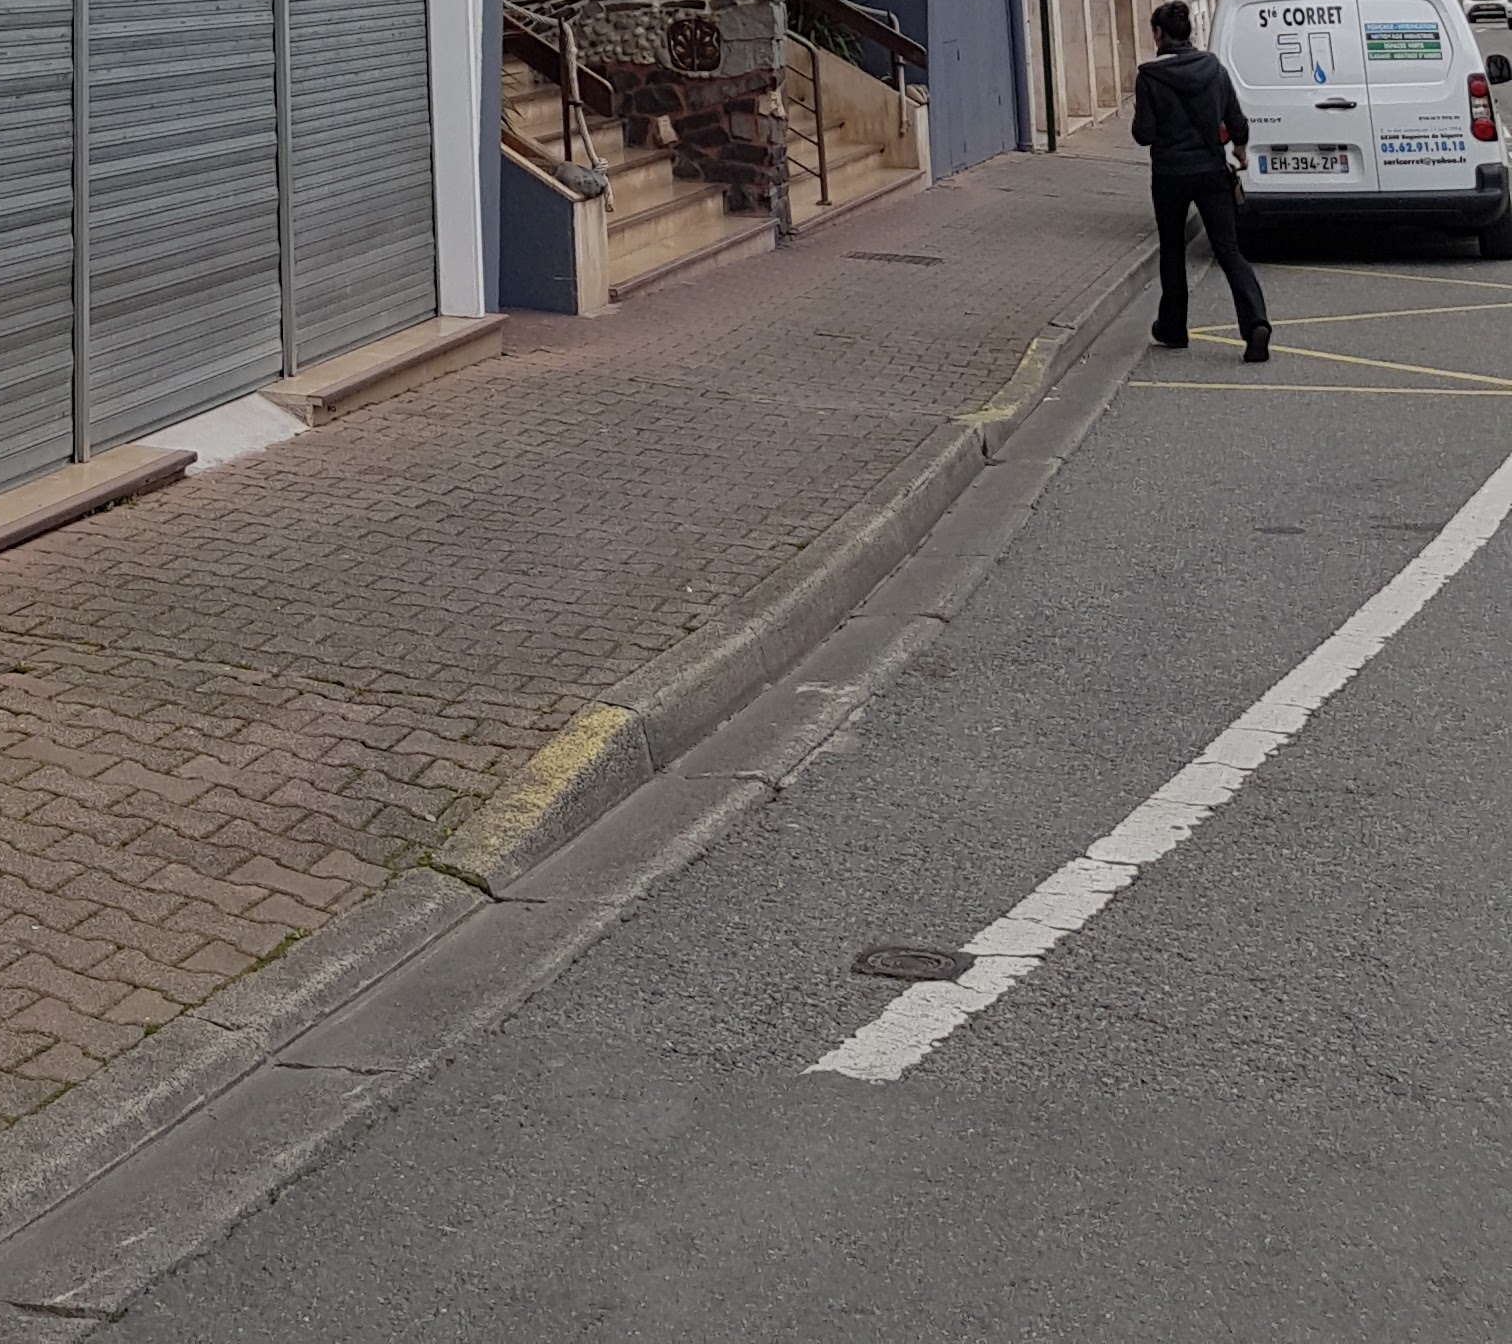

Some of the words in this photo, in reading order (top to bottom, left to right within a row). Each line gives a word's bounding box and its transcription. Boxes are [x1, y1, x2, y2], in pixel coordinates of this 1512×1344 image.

[1259, 6, 1278, 28] Sté
[1282, 5, 1343, 27] CORRET
[1271, 157, 1338, 170] EH-394-ZP
